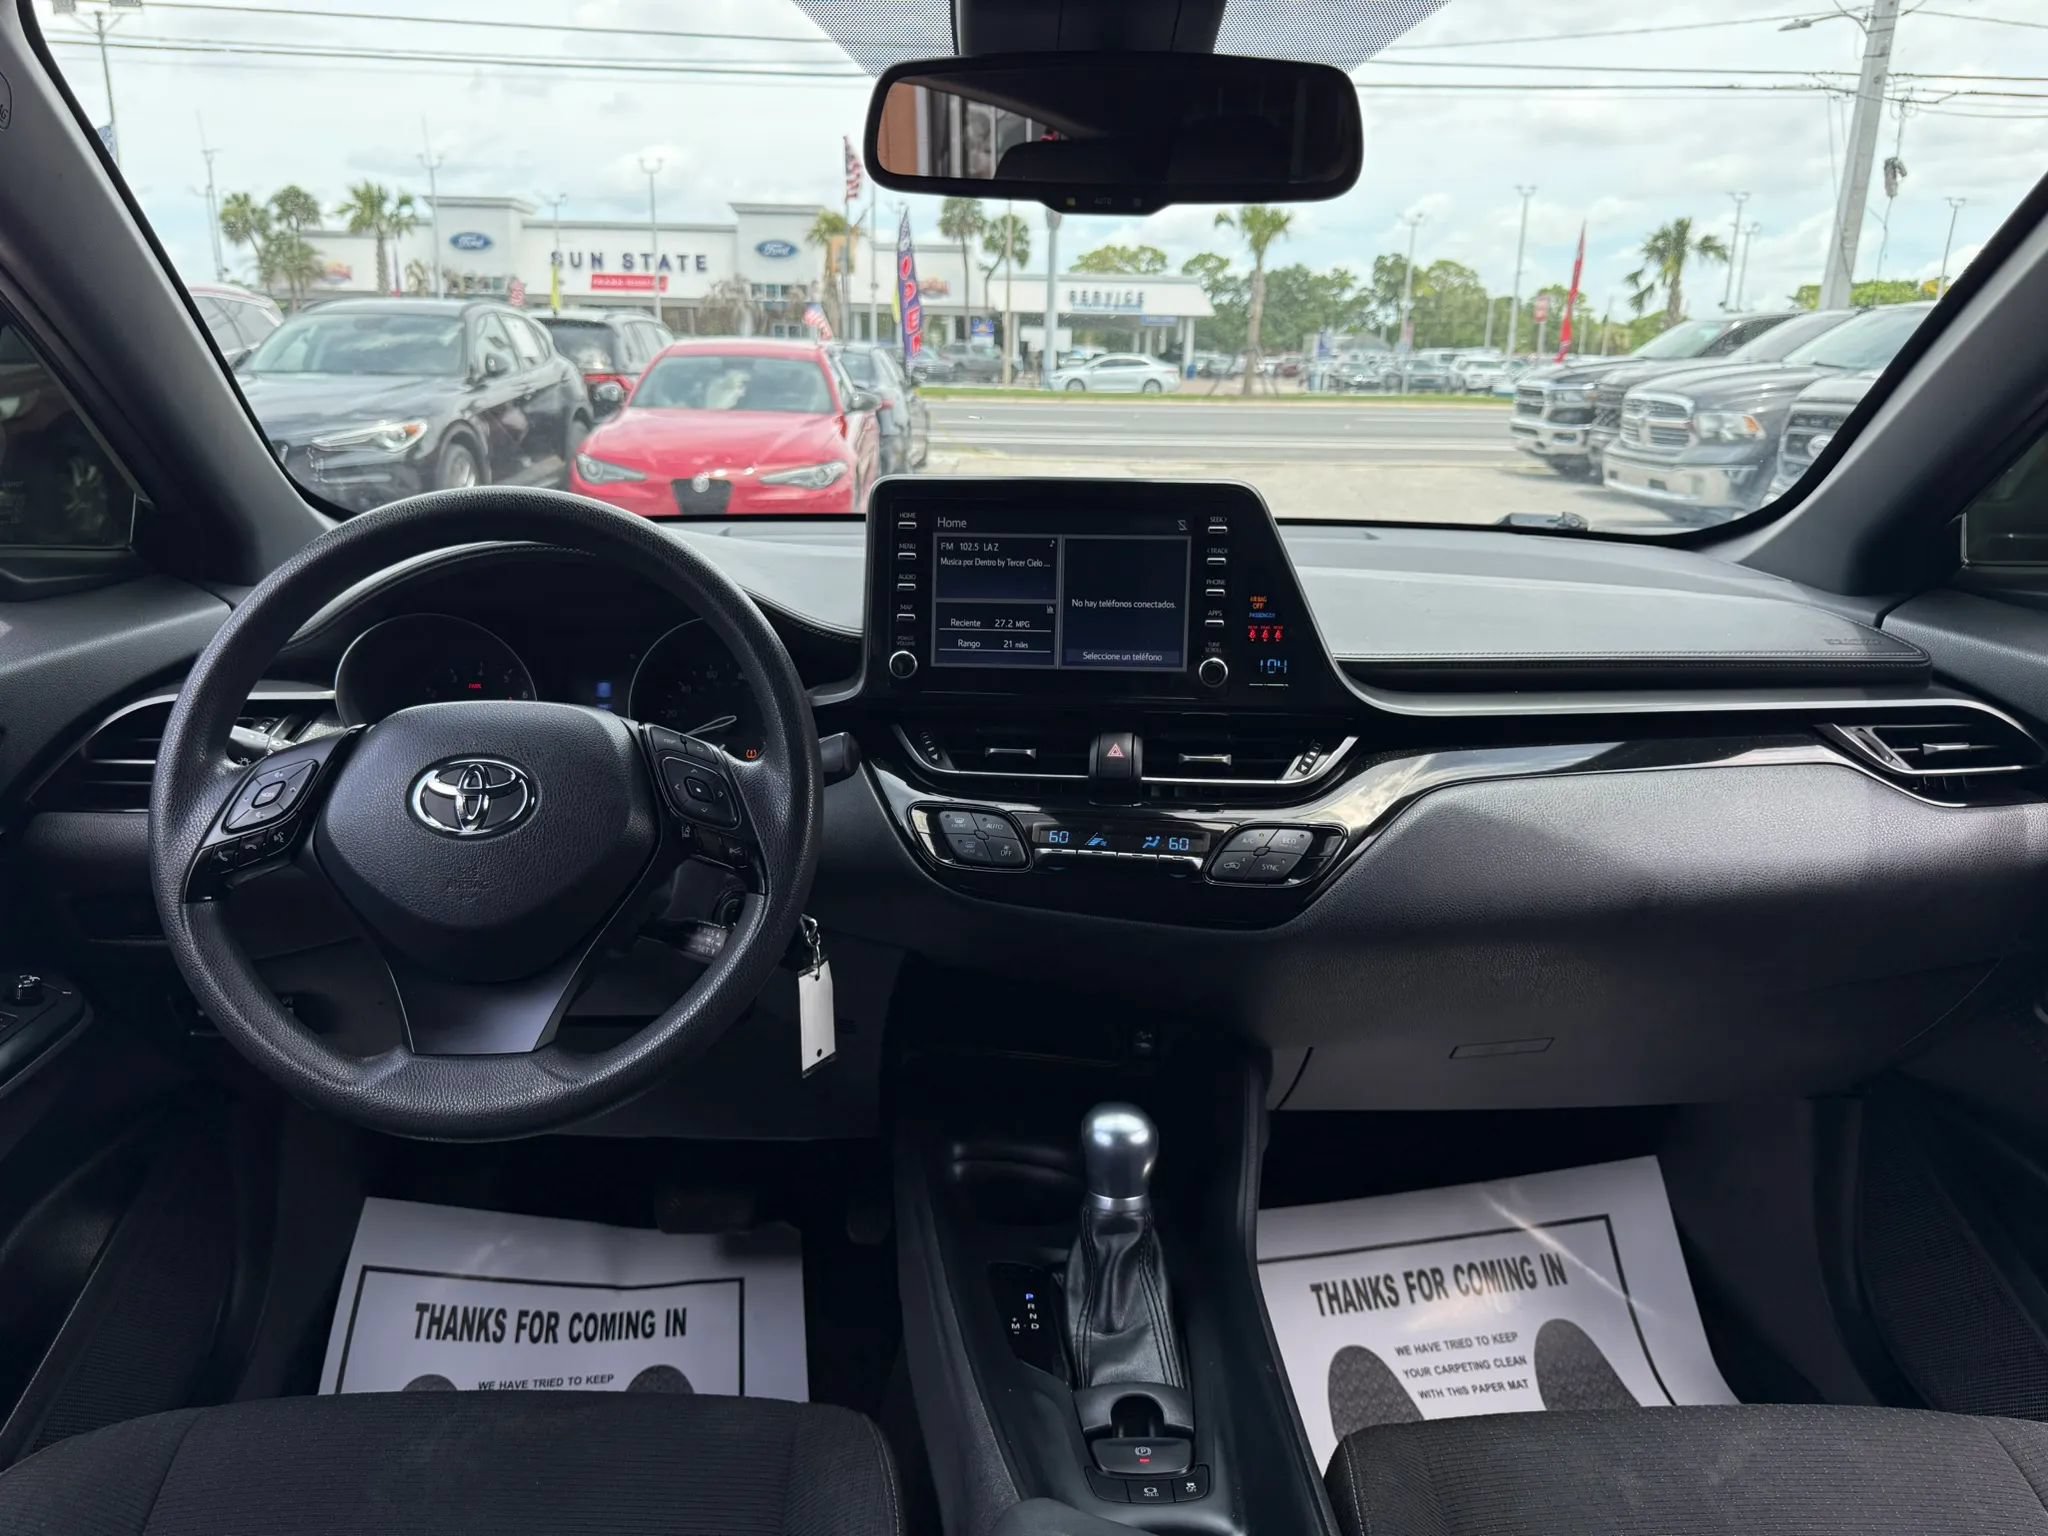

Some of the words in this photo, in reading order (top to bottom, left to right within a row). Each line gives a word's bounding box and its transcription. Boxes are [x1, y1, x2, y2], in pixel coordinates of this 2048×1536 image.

[551, 252, 604, 270] SUN
[622, 252, 708, 272] STATE
[937, 517, 967, 528] Home
[940, 542, 954, 551] FM
[959, 542, 979, 551] 102.5
[940, 557, 962, 566] Musica
[962, 559, 974, 567] por
[974, 557, 997, 566] Dentro
[997, 558, 1005, 568] by
[1007, 558, 1025, 567] Tercer
[1026, 558, 1043, 567] Cielo
[1071, 599, 1083, 607] No
[1084, 599, 1097, 609] hay
[1099, 599, 1132, 608] teléfonos
[1133, 600, 1176, 609] conectados.
[950, 618, 981, 628] Reciente
[994, 619, 1013, 628] 27.2
[1015, 620, 1030, 628] MPG
[957, 639, 981, 649] Rango
[1003, 640, 1013, 648] 21
[1015, 641, 1029, 649] miles
[1082, 651, 1121, 661] Seleccione
[1121, 653, 1131, 661] un
[1132, 652, 1163, 662] teléfono
[1048, 830, 1069, 844] 60
[1168, 837, 1190, 851] 60
[1000, 849, 1013, 857] OFF
[1261, 863, 1280, 872] SYNC
[1309, 1273, 1400, 1317] THANKS
[1403, 1266, 1450, 1304] FOR
[1452, 1255, 1538, 1297] COMING
[1539, 1252, 1568, 1287] IN
[1025, 1292, 1034, 1300] P
[1029, 1312, 1037, 1320] N
[414, 1301, 508, 1344] THANKS
[514, 1308, 561, 1345] FOR
[568, 1309, 656, 1344] COMING
[664, 1307, 687, 1338] IN
[1011, 1322, 1020, 1330] M
[1031, 1322, 1040, 1330] D
[1394, 1344, 1413, 1357] WE
[1413, 1341, 1442, 1354] HAVE
[1442, 1337, 1474, 1351] TRIED
[1474, 1335, 1490, 1347] TO
[1490, 1331, 1518, 1345] KEEP
[1402, 1366, 1433, 1379] YOUR
[1433, 1358, 1491, 1376] CARPETING
[1492, 1354, 1528, 1369] CLEAN
[478, 1380, 496, 1390] WE
[499, 1379, 529, 1389] HAVE
[533, 1377, 564, 1388] TRIED
[567, 1375, 583, 1386] TO
[585, 1373, 615, 1385] KEEP
[1417, 1387, 1445, 1400] WITH
[1445, 1385, 1470, 1397] THIS
[1471, 1380, 1506, 1395] PAPER
[1506, 1378, 1529, 1391] MAT
